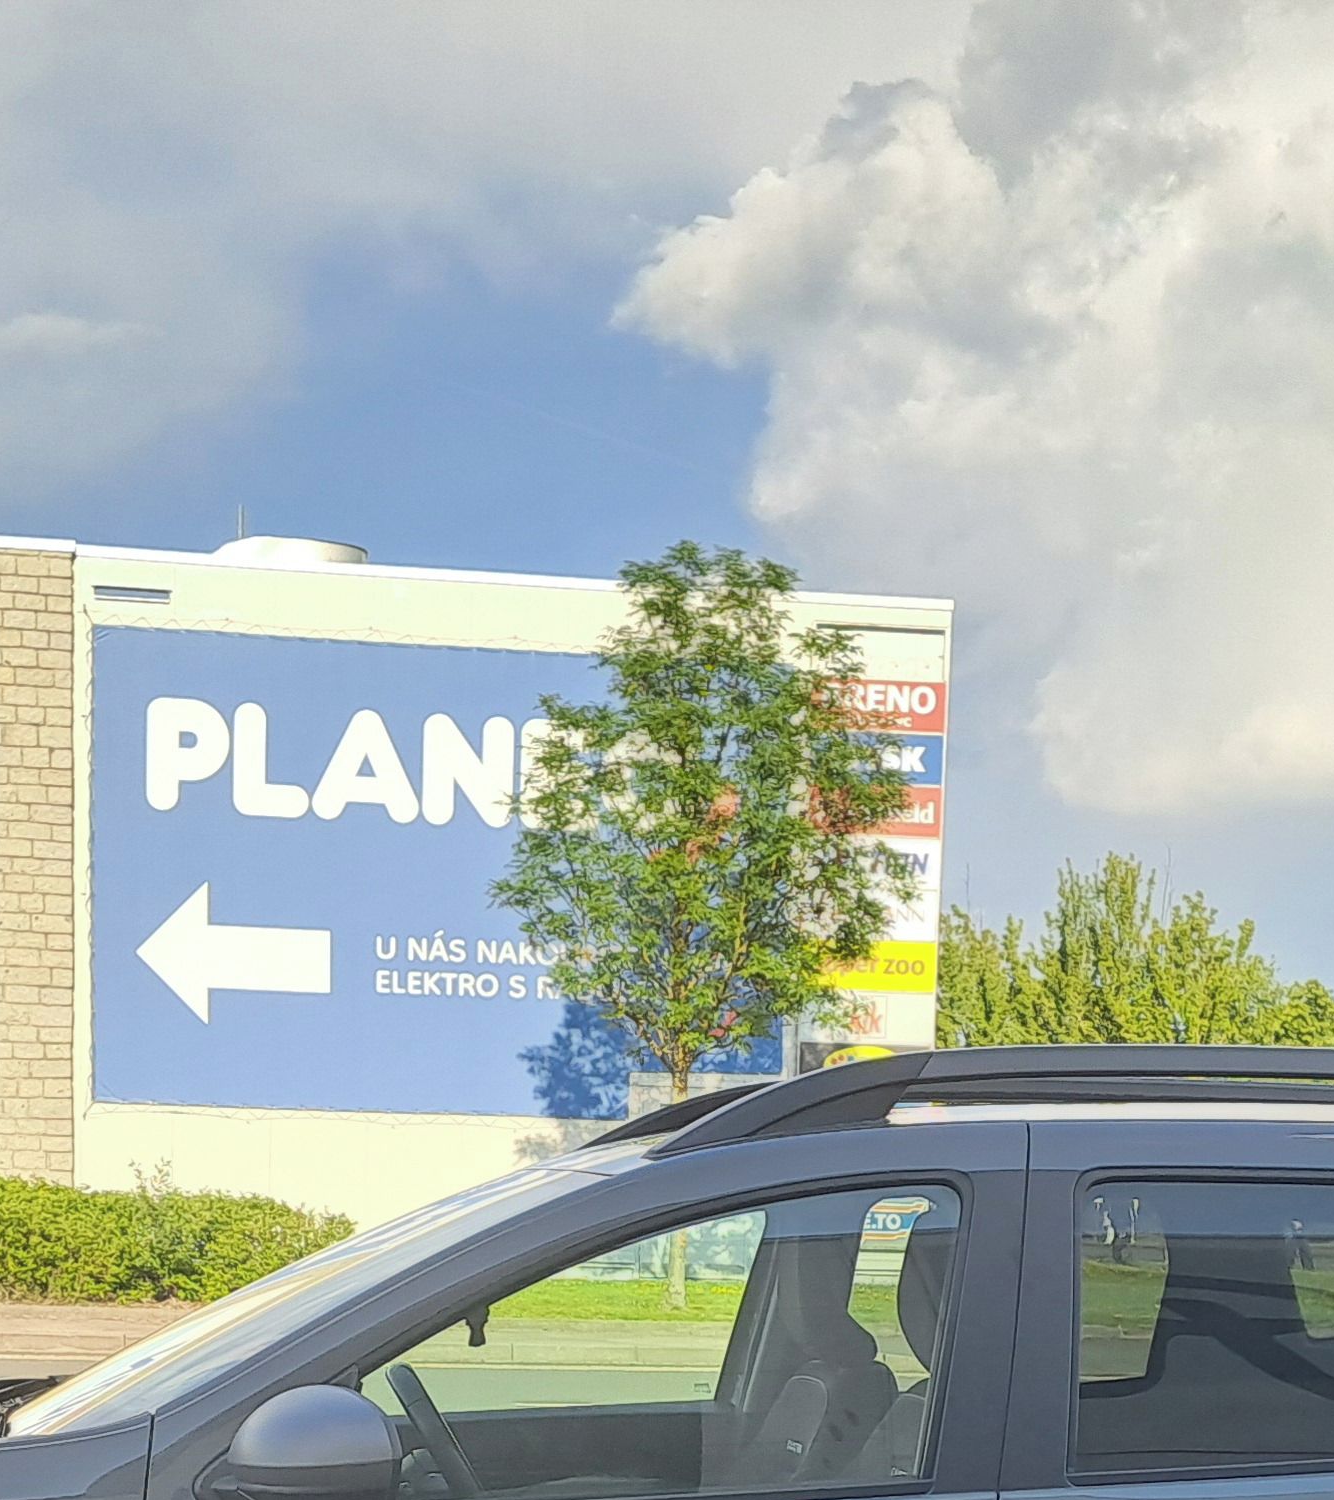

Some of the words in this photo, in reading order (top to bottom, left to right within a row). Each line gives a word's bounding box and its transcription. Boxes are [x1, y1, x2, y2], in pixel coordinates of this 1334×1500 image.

[874, 744, 927, 773] SK
[375, 935, 397, 960] U
[407, 930, 466, 963] NÁS
[883, 959, 926, 976] zoo
[375, 969, 499, 998] ELEKTRO
[508, 975, 527, 999] S
